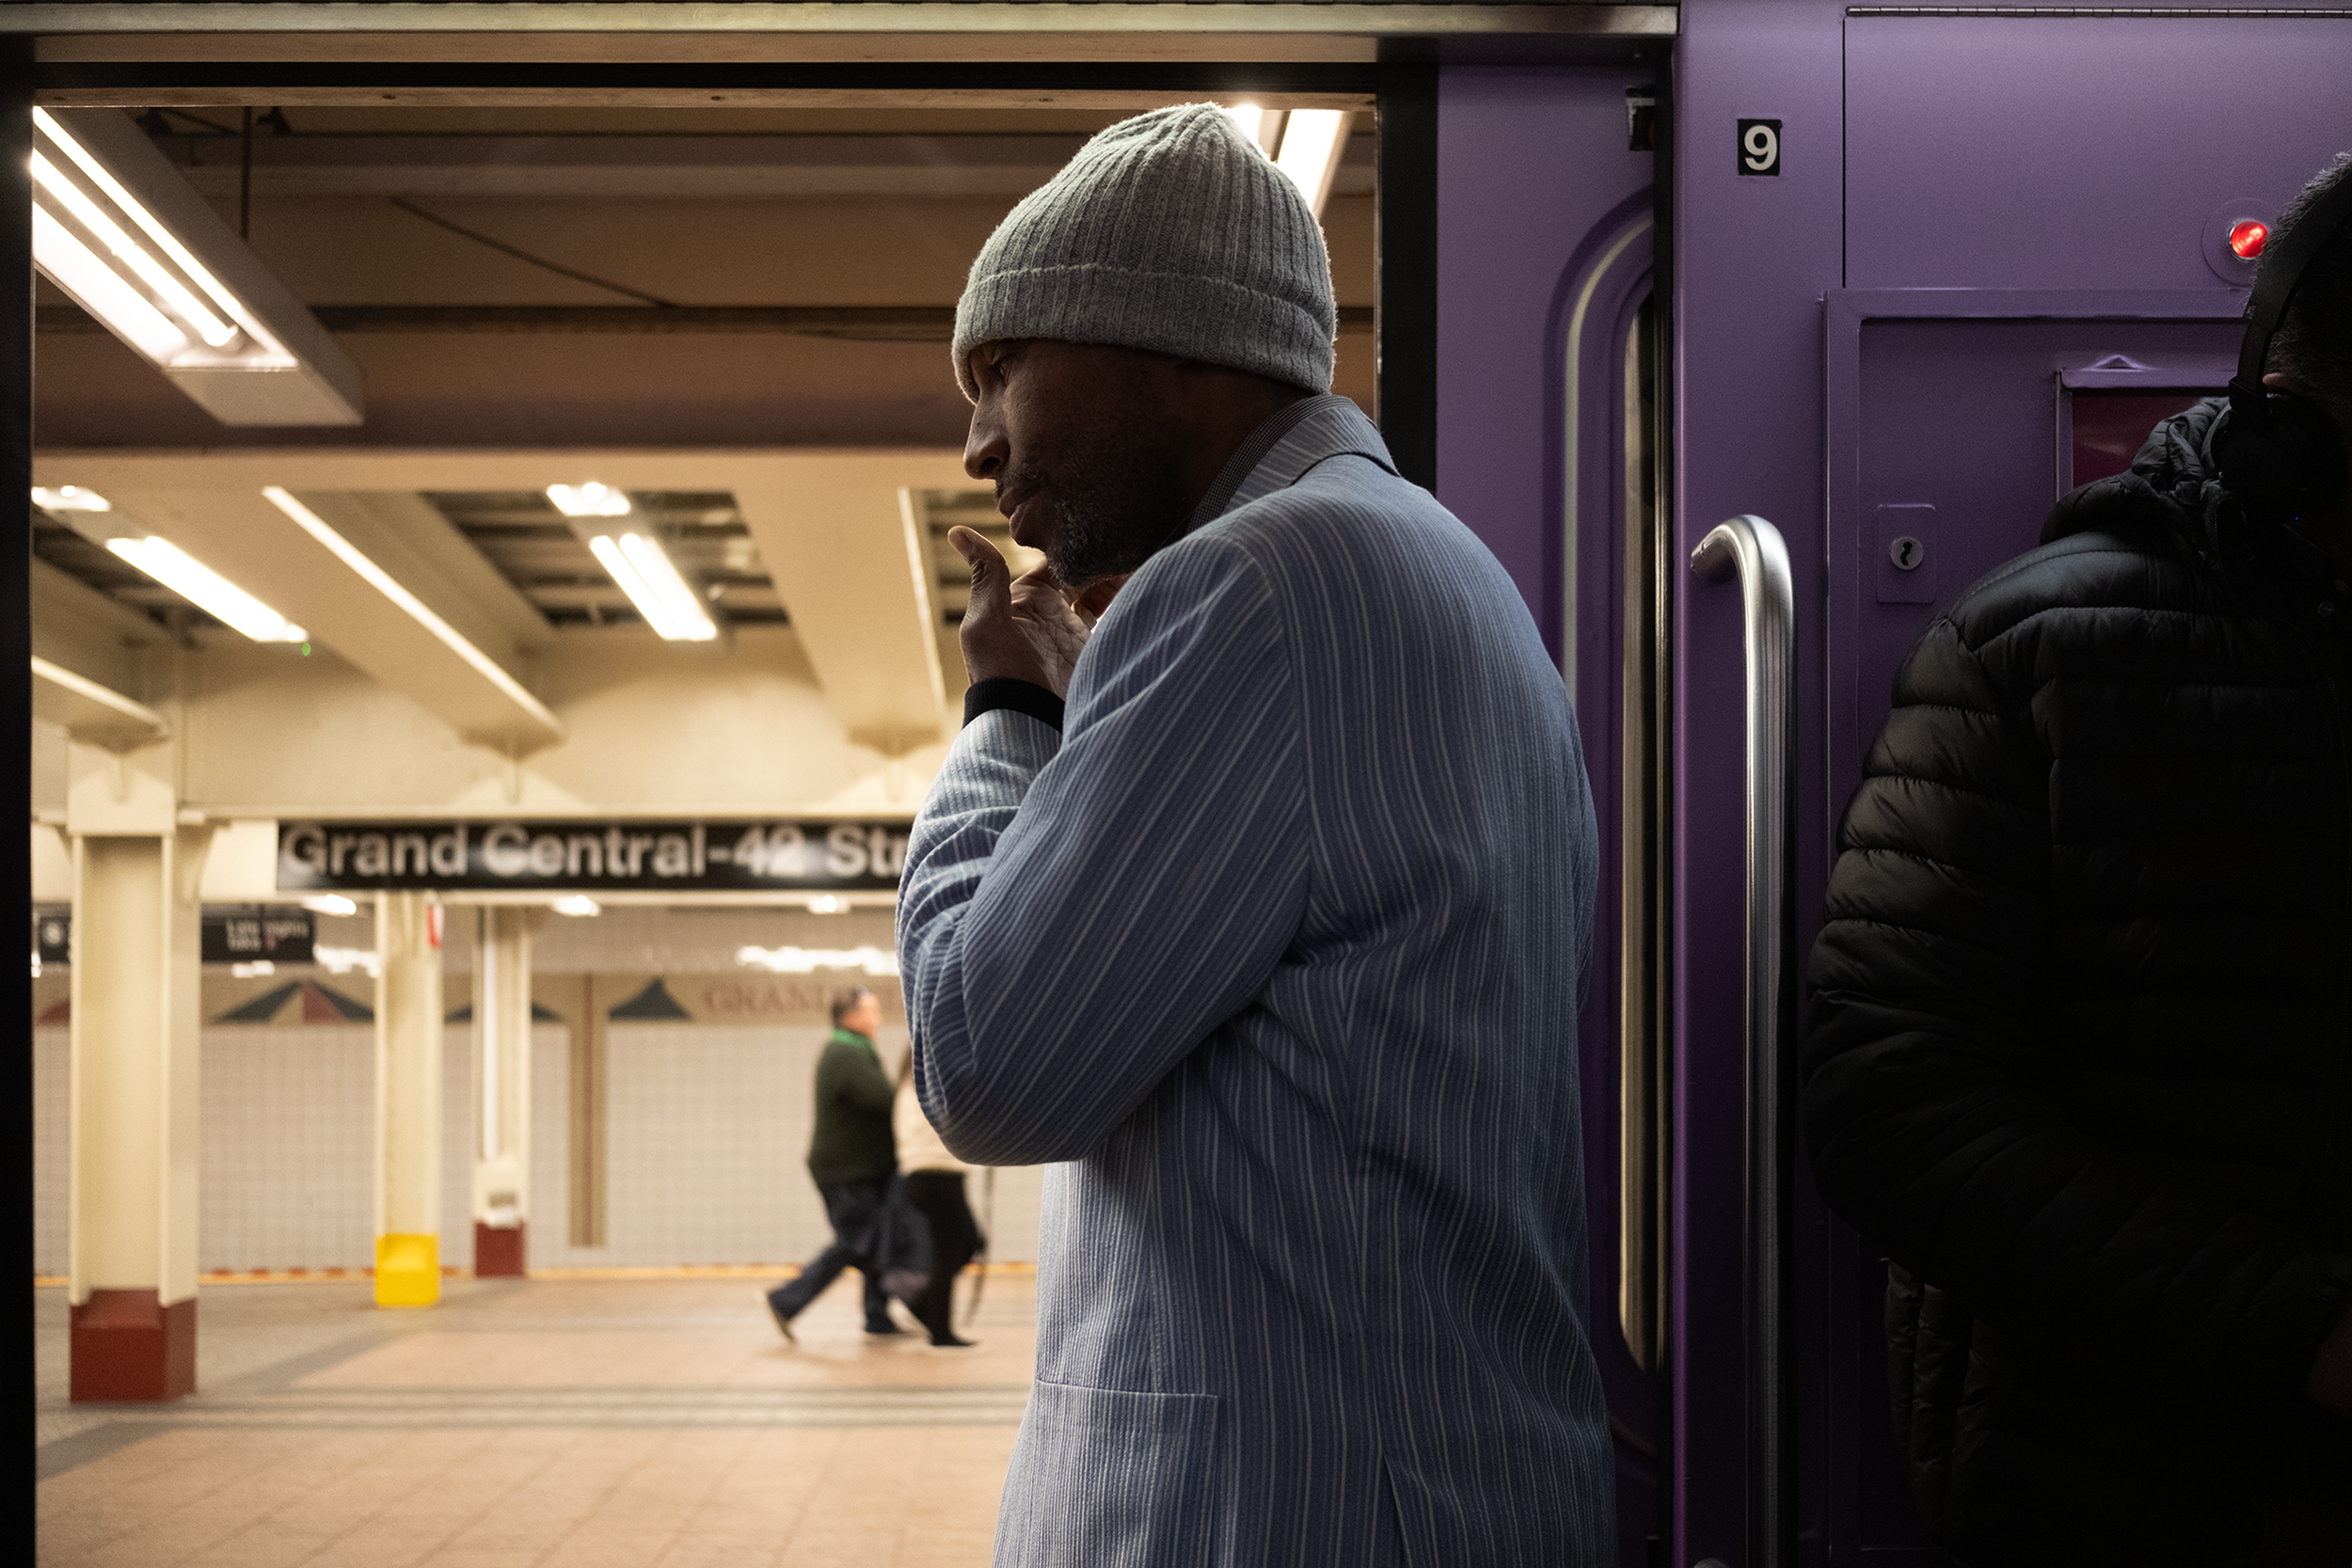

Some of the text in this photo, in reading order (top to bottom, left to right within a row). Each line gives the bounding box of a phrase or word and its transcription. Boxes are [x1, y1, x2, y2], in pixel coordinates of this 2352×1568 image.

[1744, 124, 1778, 171] 9
[285, 826, 468, 877] Grand
[484, 825, 805, 878] Central-42
